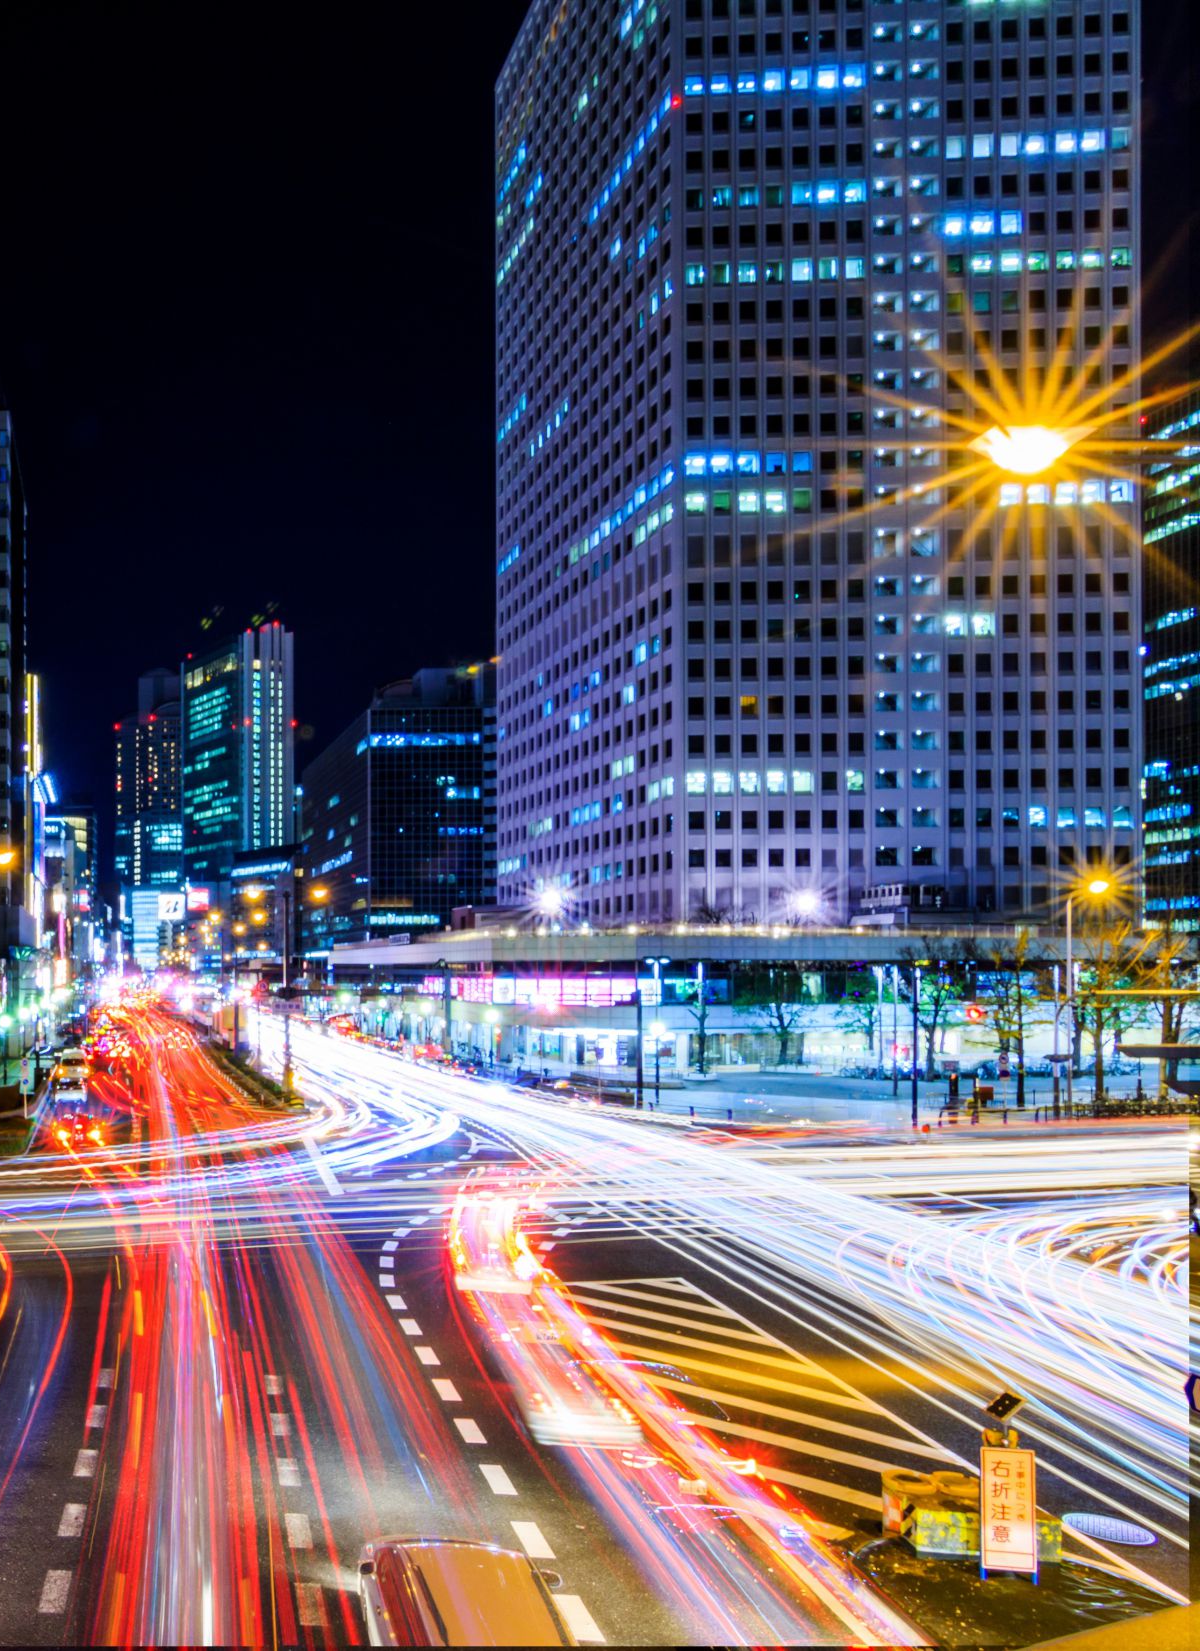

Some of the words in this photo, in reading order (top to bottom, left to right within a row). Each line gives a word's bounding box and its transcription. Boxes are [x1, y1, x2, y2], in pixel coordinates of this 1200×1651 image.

[990, 1460, 1011, 1543] 右折注意
[1016, 1460, 1025, 1522] 工事中につき
